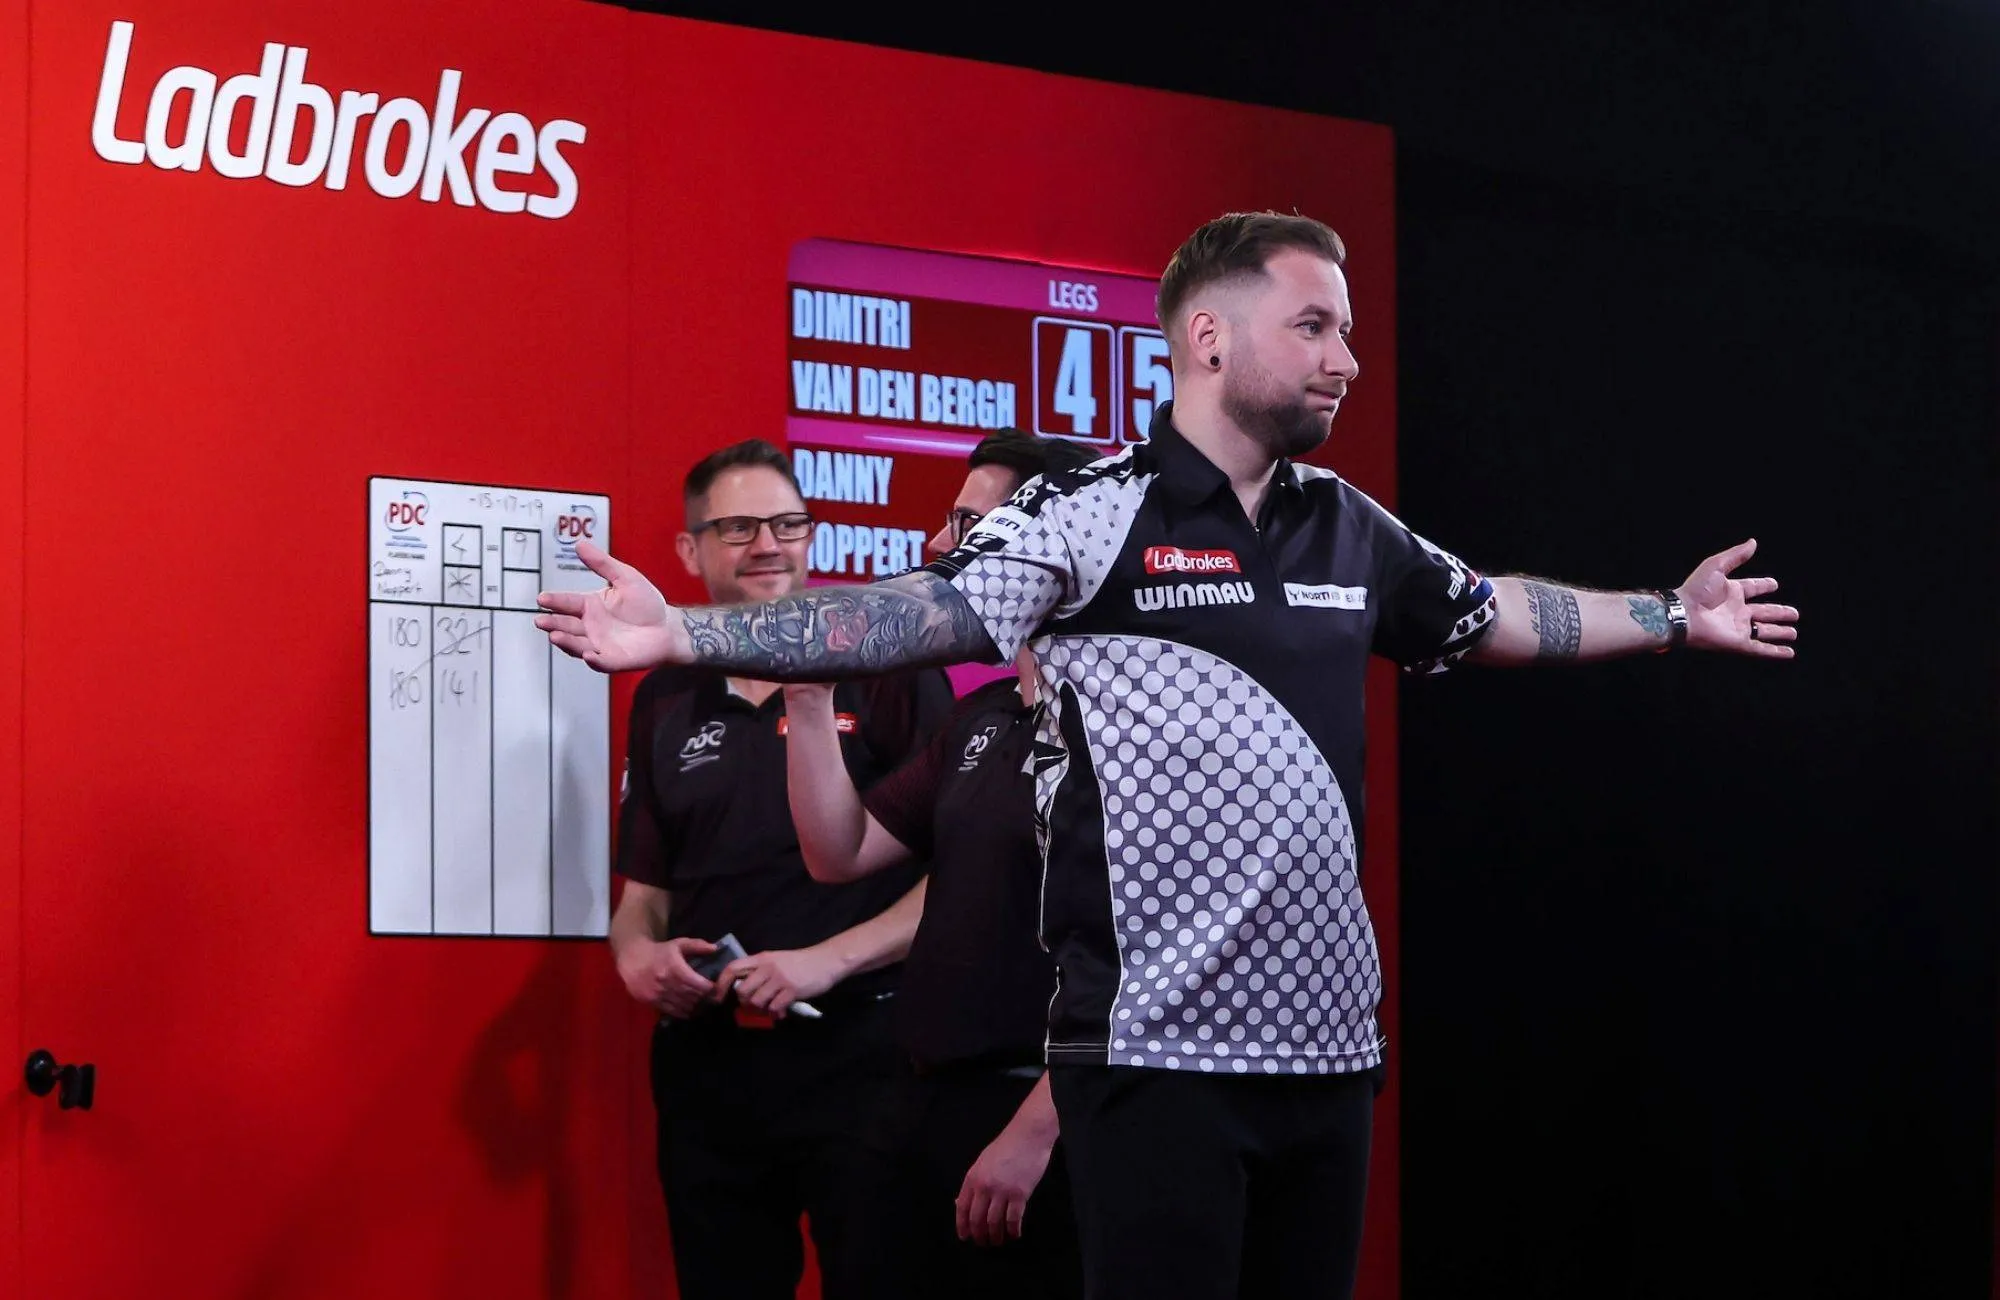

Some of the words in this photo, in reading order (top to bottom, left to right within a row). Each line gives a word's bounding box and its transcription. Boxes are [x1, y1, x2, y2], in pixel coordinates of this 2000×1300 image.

[92, 20, 588, 220] Ladbrokes
[1048, 279, 1099, 312] LEGS
[792, 287, 911, 350] DIMITRI
[791, 359, 853, 416] VAN
[858, 367, 914, 421] DEN
[920, 373, 1017, 430] BERGH
[1054, 328, 1097, 434] 4
[1133, 335, 1174, 439] 5
[794, 448, 893, 506] DANNY
[388, 502, 425, 526] PDC
[558, 514, 593, 538] PDC
[1153, 549, 1234, 571] Ladbrokes
[1133, 580, 1257, 612] WINMAU
[389, 616, 421, 647] 180
[440, 668, 478, 708] 141
